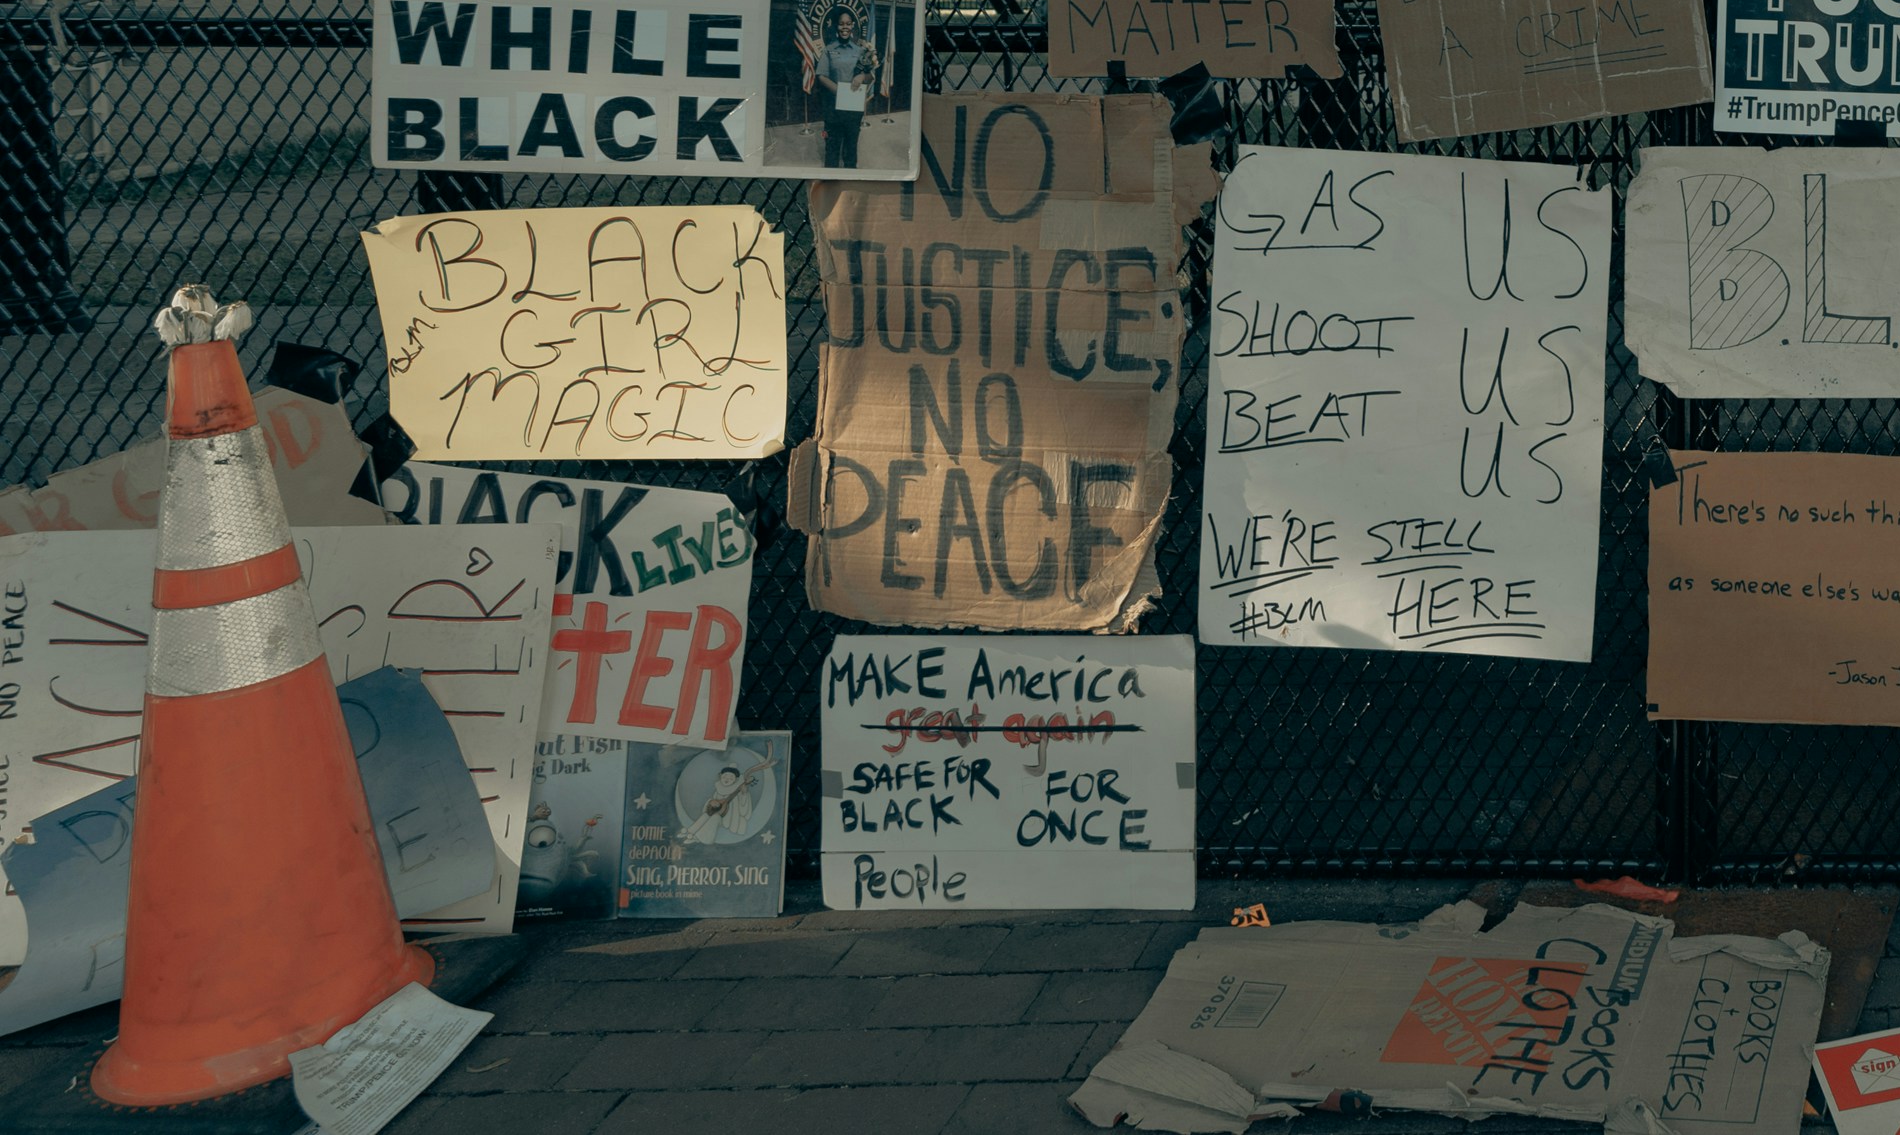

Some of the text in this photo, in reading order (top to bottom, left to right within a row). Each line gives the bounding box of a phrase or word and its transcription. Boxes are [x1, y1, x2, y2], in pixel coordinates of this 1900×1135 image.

[390, 0, 743, 79] WHILE
[1068, 0, 1298, 55] MATTER
[387, 93, 744, 163] BLACK
[1219, 153, 1588, 301] GAS US
[416, 217, 781, 312] BLACK
[500, 291, 779, 379] GIRL
[1215, 291, 1580, 426] SHOOT US
[439, 367, 760, 455] MAGIC
[909, 358, 1025, 463] NO
[1223, 389, 1401, 448] BEAT
[1366, 518, 1494, 561] STILL
[1809, 502, 1854, 524] such
[1388, 578, 1537, 633] HERE
[1711, 577, 1792, 596] someone
[828, 647, 1147, 708] MAKE America
[552, 760, 591, 775] Dark
[845, 760, 935, 794] SAFE
[1046, 769, 1130, 805] FOR
[841, 796, 1150, 850] BLACK ONCE
[1607, 926, 1661, 993] MEDIUM
